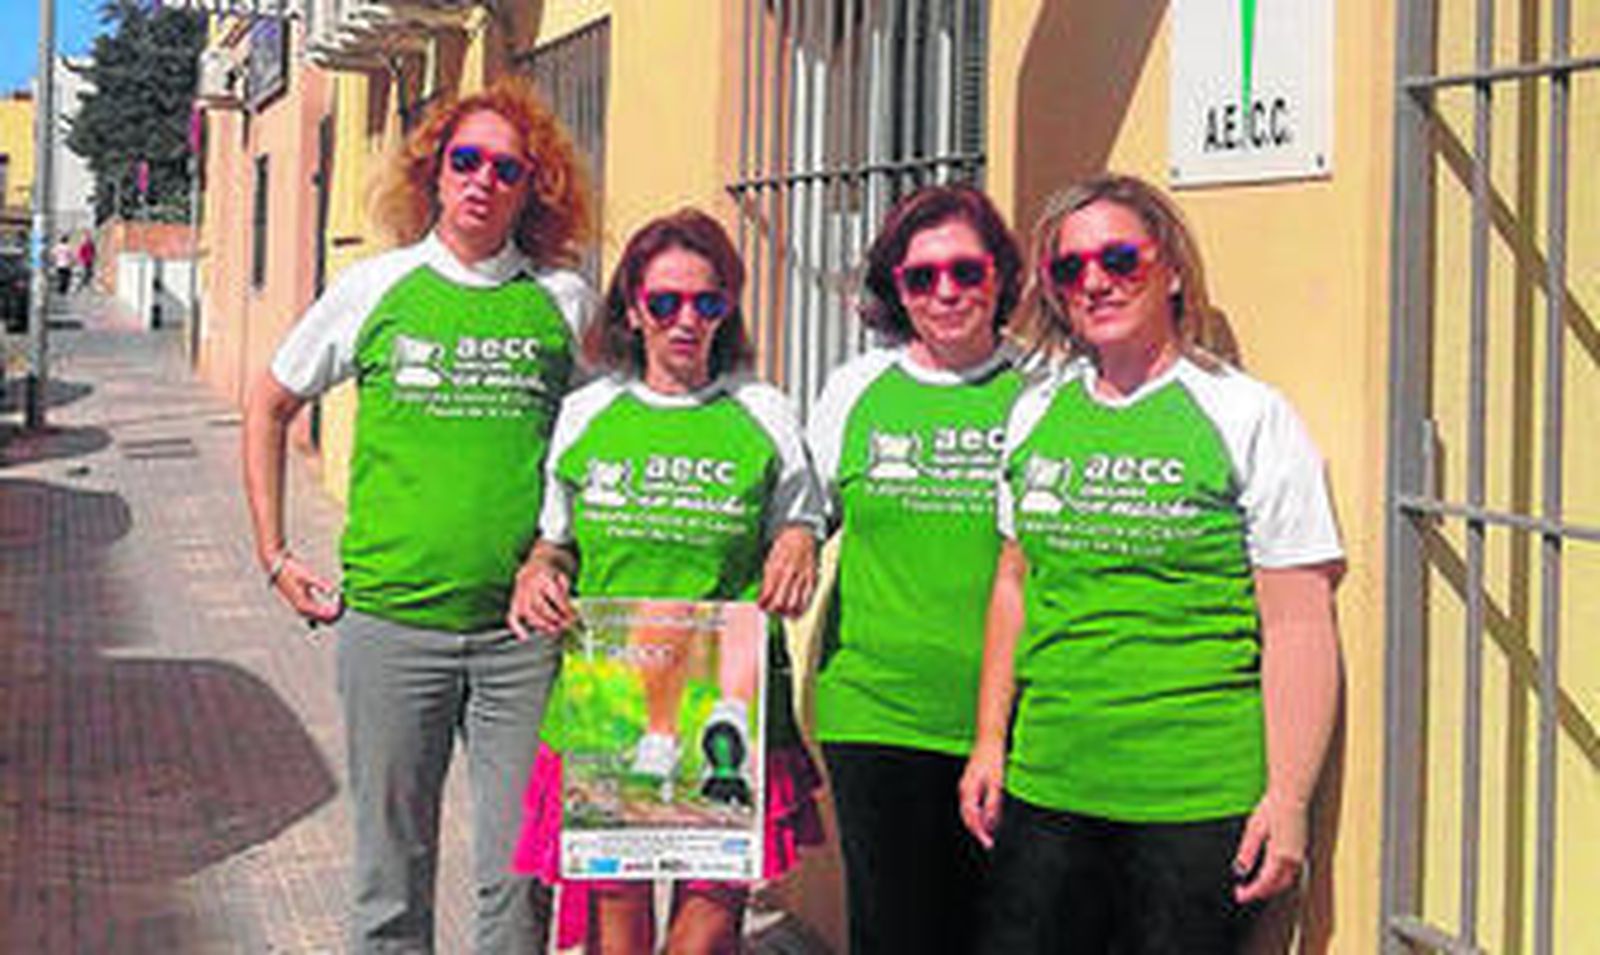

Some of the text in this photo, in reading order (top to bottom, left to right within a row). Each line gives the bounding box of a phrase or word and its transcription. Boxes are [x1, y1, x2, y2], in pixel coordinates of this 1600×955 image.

[456, 336, 541, 360] aecc
[646, 455, 737, 484] aecc
[1083, 455, 1185, 484] aecc
